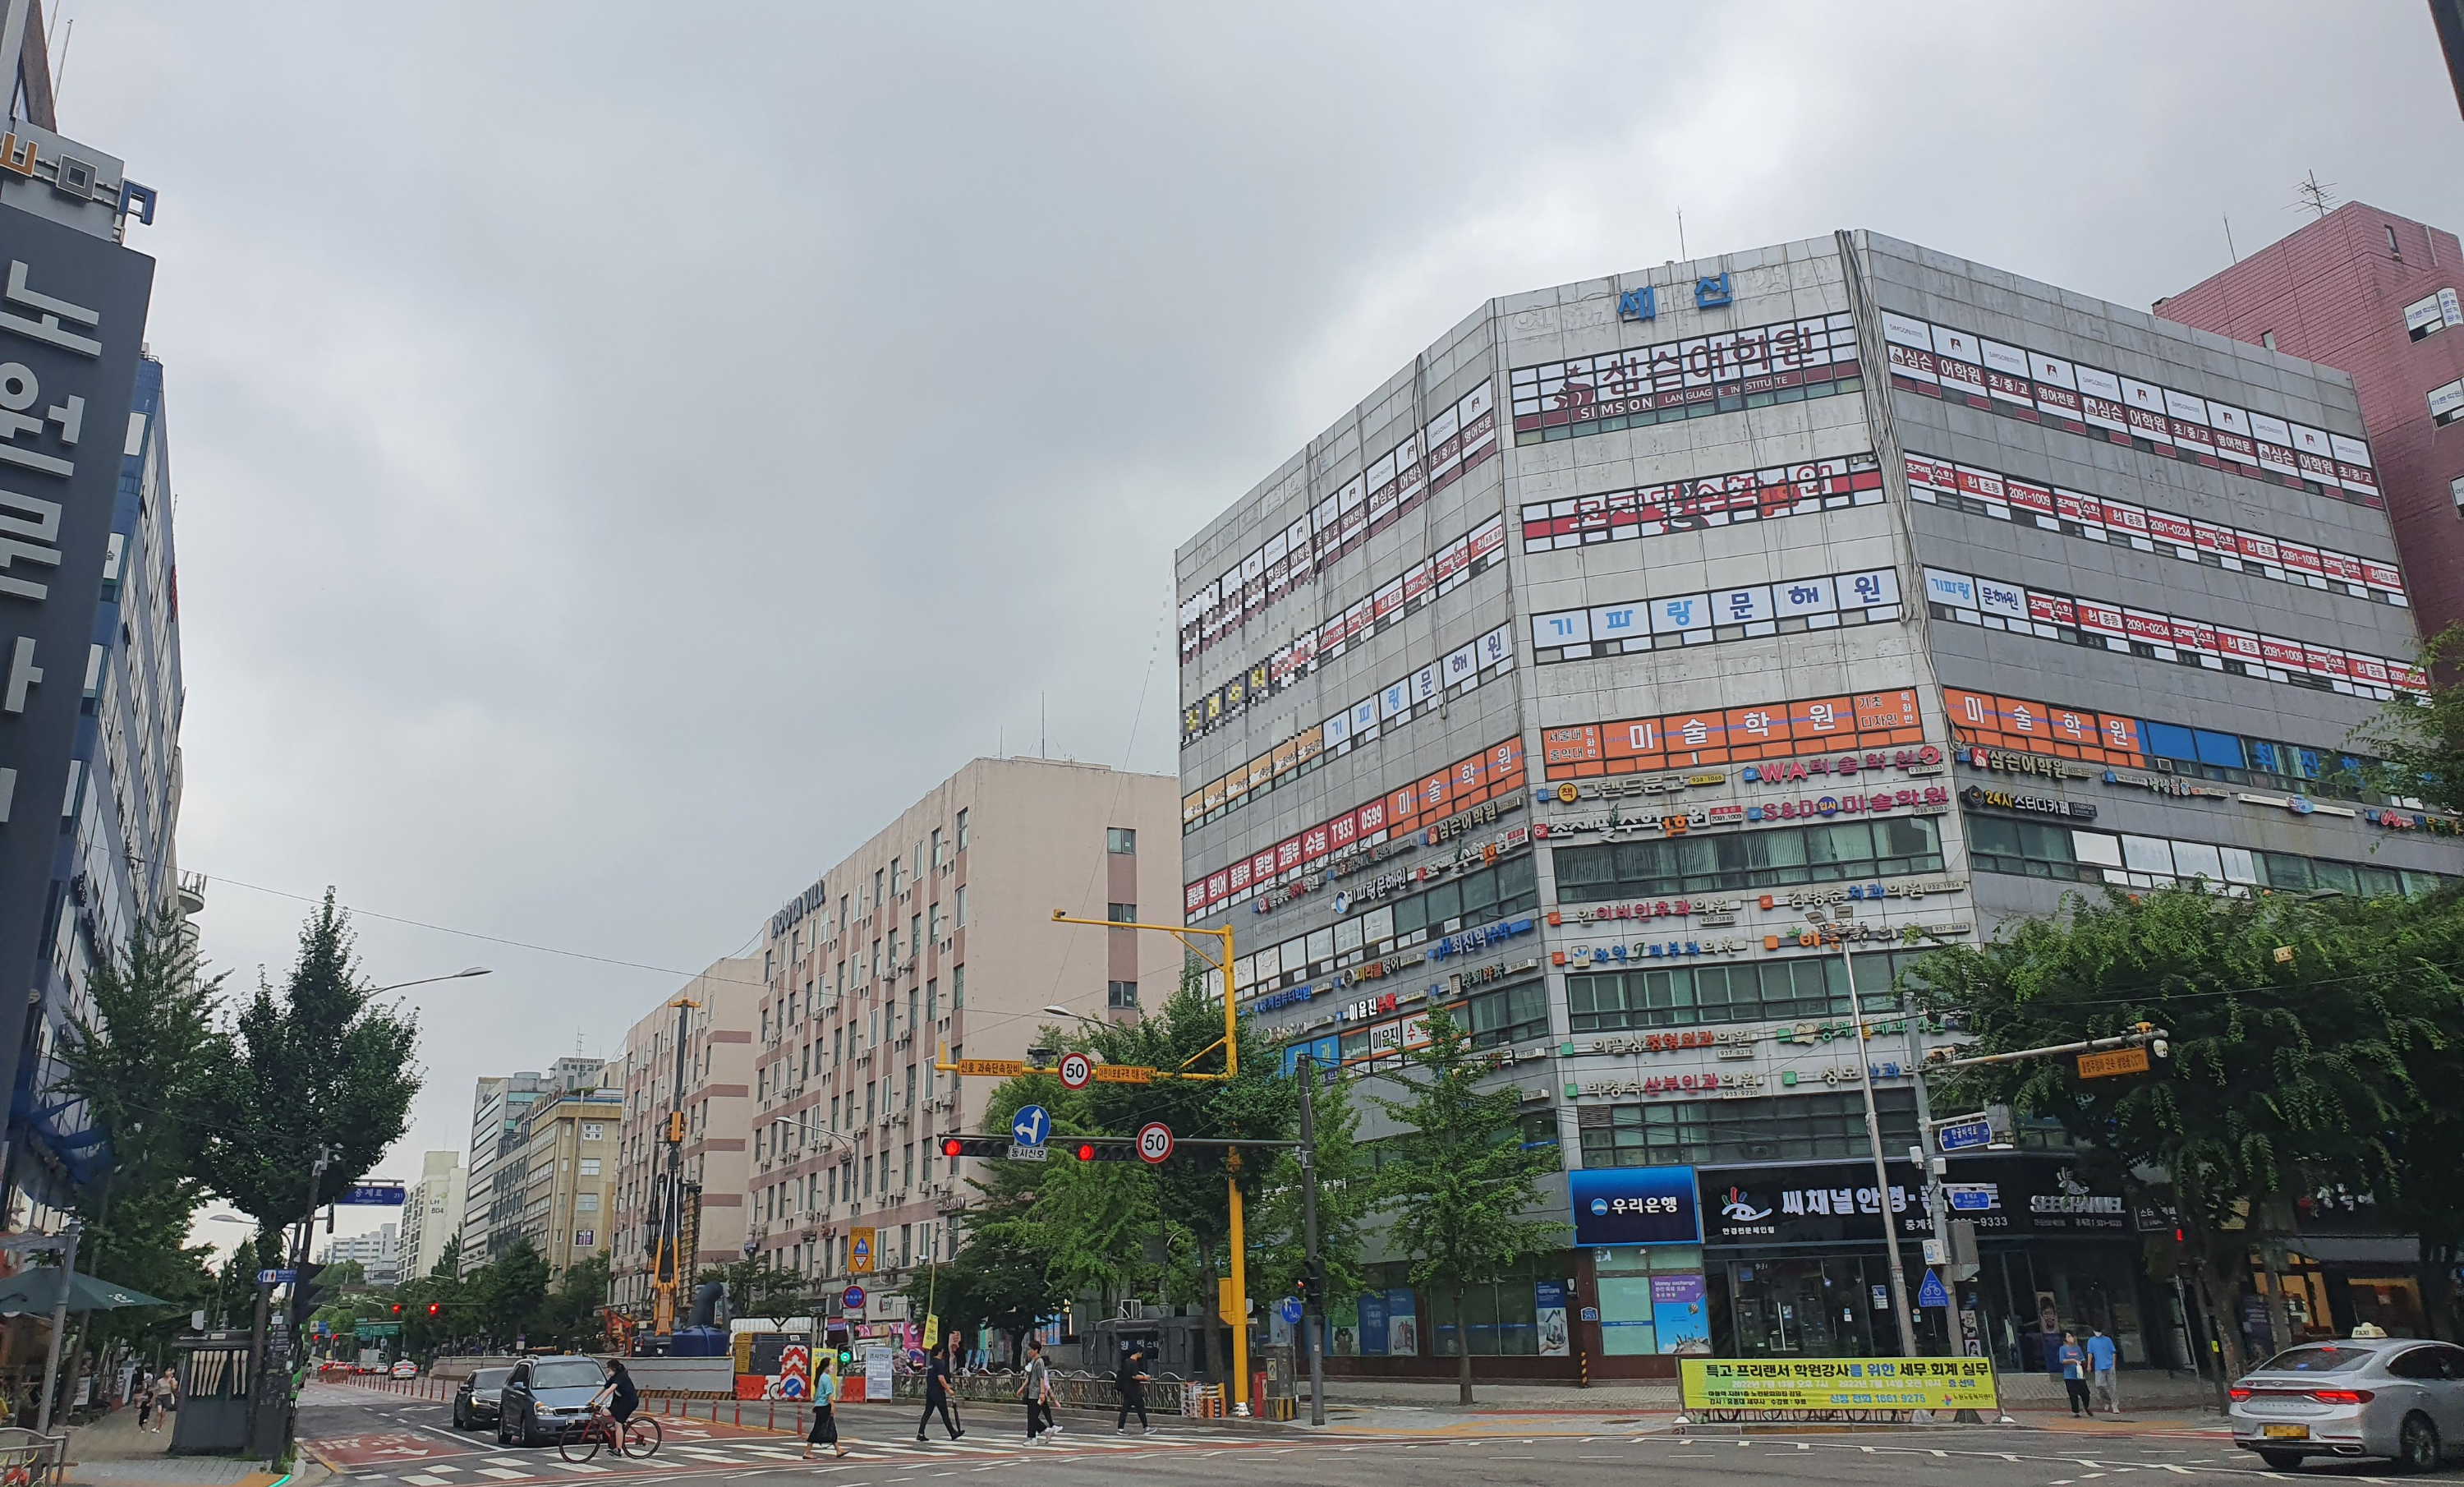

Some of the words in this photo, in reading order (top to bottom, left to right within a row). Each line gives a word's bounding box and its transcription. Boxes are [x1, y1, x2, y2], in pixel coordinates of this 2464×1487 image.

[1602, 326, 1813, 396] 심슨어학원
[1580, 395, 1653, 419] SIMSON
[1665, 386, 1724, 403] LANGUAGE
[1729, 374, 1788, 395] INSTITUTE
[1905, 349, 1933, 370] 심슨
[1941, 359, 1982, 384] 어학원
[1988, 374, 2030, 395] 초/중/고
[2038, 387, 2076, 407] 영어전문
[2098, 403, 2124, 422] 심슨
[2130, 409, 2167, 434] 어학원
[2173, 422, 2210, 442] 초/중/고
[2217, 435, 2252, 453] 영어전문
[2270, 446, 2294, 466] 심슨
[2300, 454, 2334, 478] 어학원
[2339, 466, 2373, 484] 초/중/고
[1379, 484, 1395, 504] 심슨
[1432, 436, 1459, 466] 초/중/고
[1464, 417, 1492, 442] 영어전문
[2009, 487, 2051, 506] 2091-1009
[2150, 519, 2191, 539] 2091-0234
[2281, 550, 2319, 567] 2091-1009
[1931, 578, 1970, 601] 기파랑
[1983, 587, 2018, 610] 문해원
[2126, 619, 2169, 636] 2091-0234
[2263, 646, 2303, 662] 2091-1009
[1859, 697, 1883, 709] 기초
[1629, 703, 1837, 749] 미술학원
[1861, 713, 1897, 728] 디자인
[1965, 695, 2127, 745] 미술학원
[1549, 730, 1581, 743] 서울대
[1550, 748, 1583, 761] 홍익대
[1757, 761, 1808, 782] WA
[1810, 749, 1915, 776] 미술학원
[1990, 751, 2068, 779] 심슨어학원
[1398, 746, 1511, 815] 미술학원
[1561, 787, 1573, 799] 책
[1580, 773, 1685, 799] 그랜드문고
[1763, 799, 1814, 821] S&D
[1819, 802, 1837, 810] 입시
[1843, 786, 1948, 814] 미술학원
[1985, 790, 2012, 808] 24시
[2015, 794, 2071, 815] 스터디카페
[1440, 802, 1496, 840] 심슨어학원
[1534, 826, 1546, 836] 6F
[1209, 873, 1226, 898] 영어
[1231, 863, 1250, 889] 중등부
[1255, 852, 1274, 878] 문법
[1279, 840, 1300, 867] 고등부
[1305, 831, 1326, 855] 수능
[1361, 805, 1382, 831] 0599
[1357, 956, 1399, 981] 미라클영어
[960, 1064, 974, 1074] 신호
[977, 1063, 1020, 1075] 과속단속장비
[1066, 1063, 1084, 1078] 50
[1011, 1149, 1044, 1158] 동시신호
[1145, 1135, 1165, 1150] 50
[355, 1188, 383, 1197] 중계로
[1611, 1195, 1677, 1214] 우리은행
[1867, 1364, 1895, 1377] 위한
[1962, 1363, 1988, 1375] 실무
[1875, 1394, 1897, 1402] 1661
[1901, 1394, 1925, 1402] 9275
